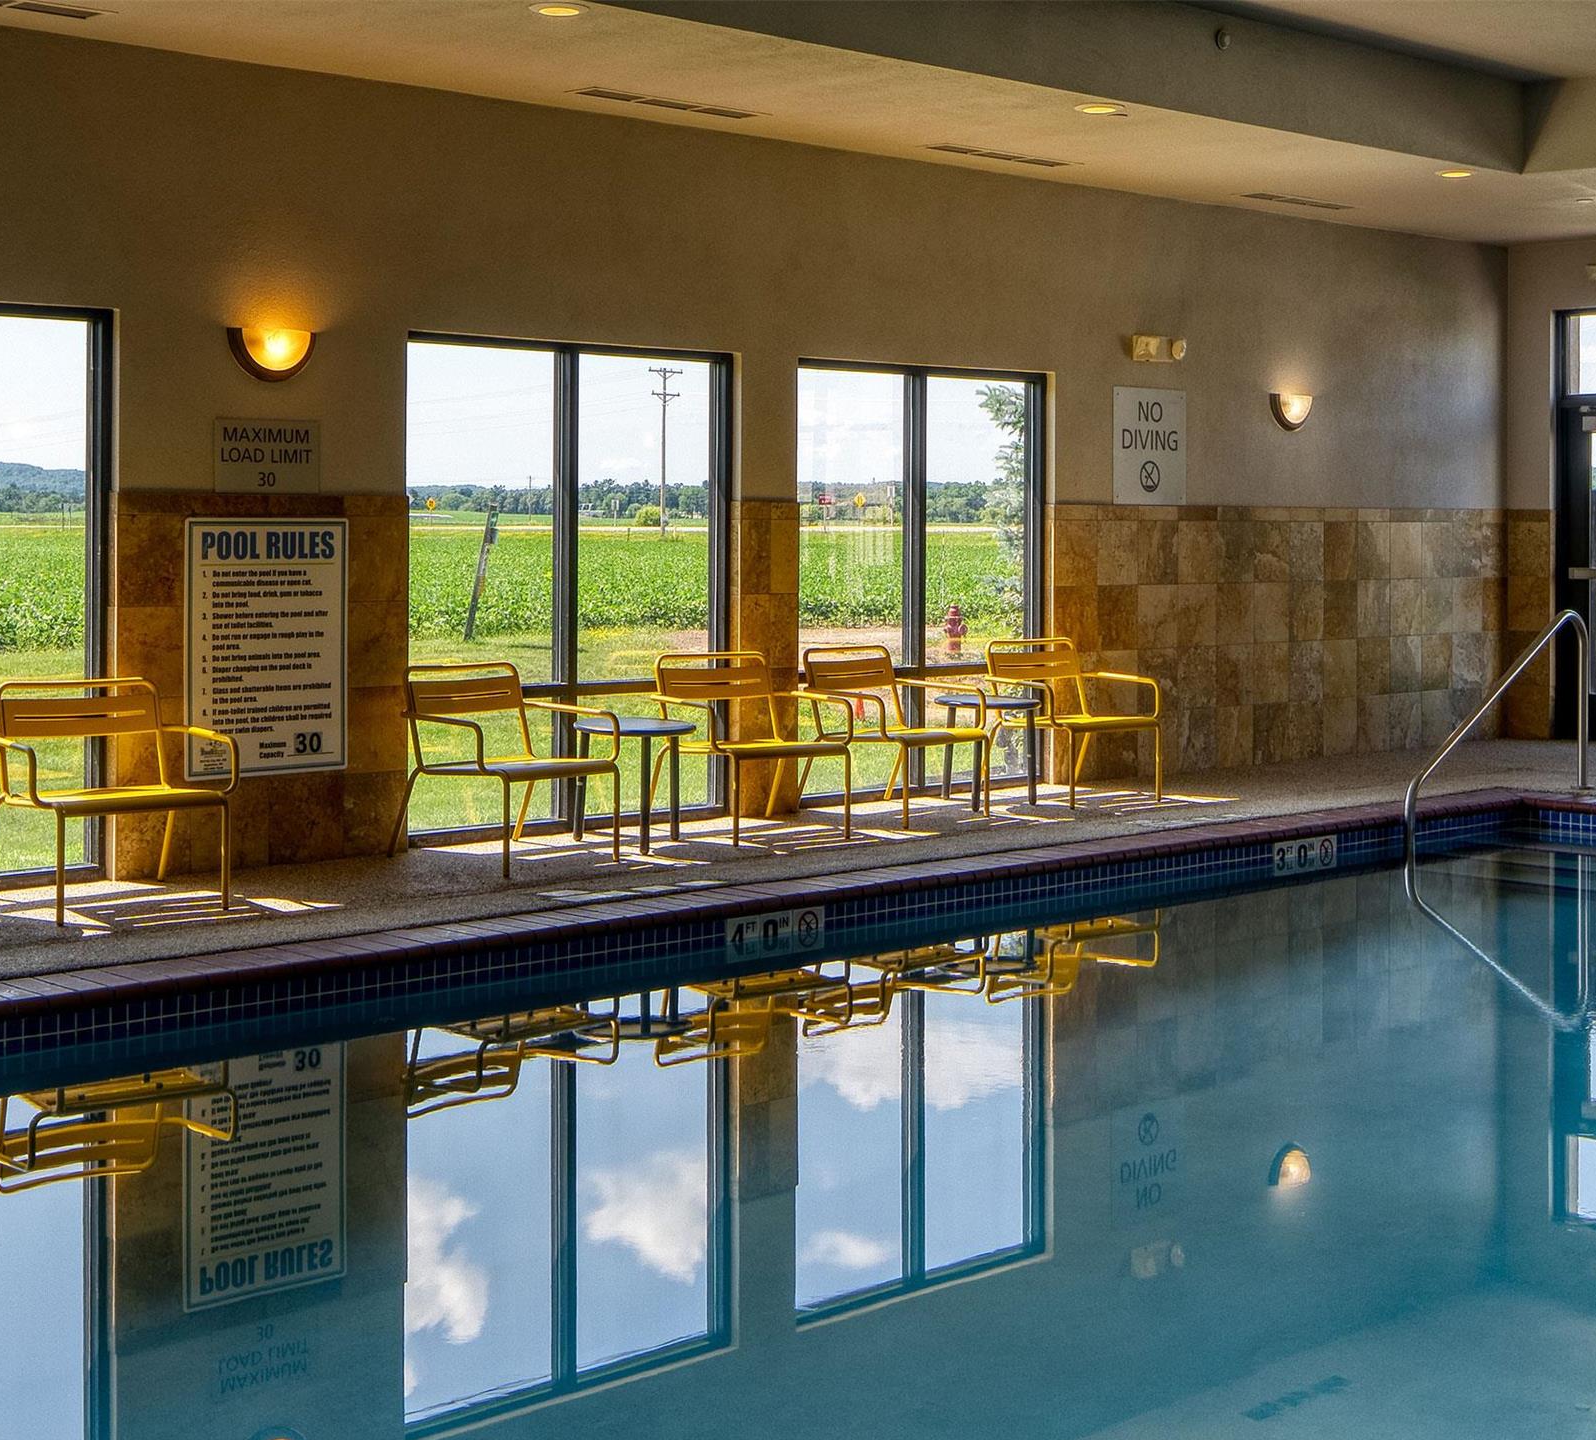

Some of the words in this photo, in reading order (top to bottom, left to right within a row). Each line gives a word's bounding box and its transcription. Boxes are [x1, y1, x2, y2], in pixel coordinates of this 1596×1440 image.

[1138, 401, 1163, 423] NO
[223, 427, 309, 444] MAXIMUM
[1122, 429, 1178, 451] DIVING
[221, 447, 265, 463] LOAD
[271, 449, 312, 464] LIMIT
[257, 471, 276, 488] 30
[201, 530, 260, 561] POOL
[266, 530, 335, 560] RULES
[295, 732, 322, 754] 30
[259, 751, 284, 759] Capacity
[1287, 846, 1293, 855] FT
[731, 923, 744, 942] 4
[746, 922, 756, 933] FT
[779, 917, 789, 928] IN
